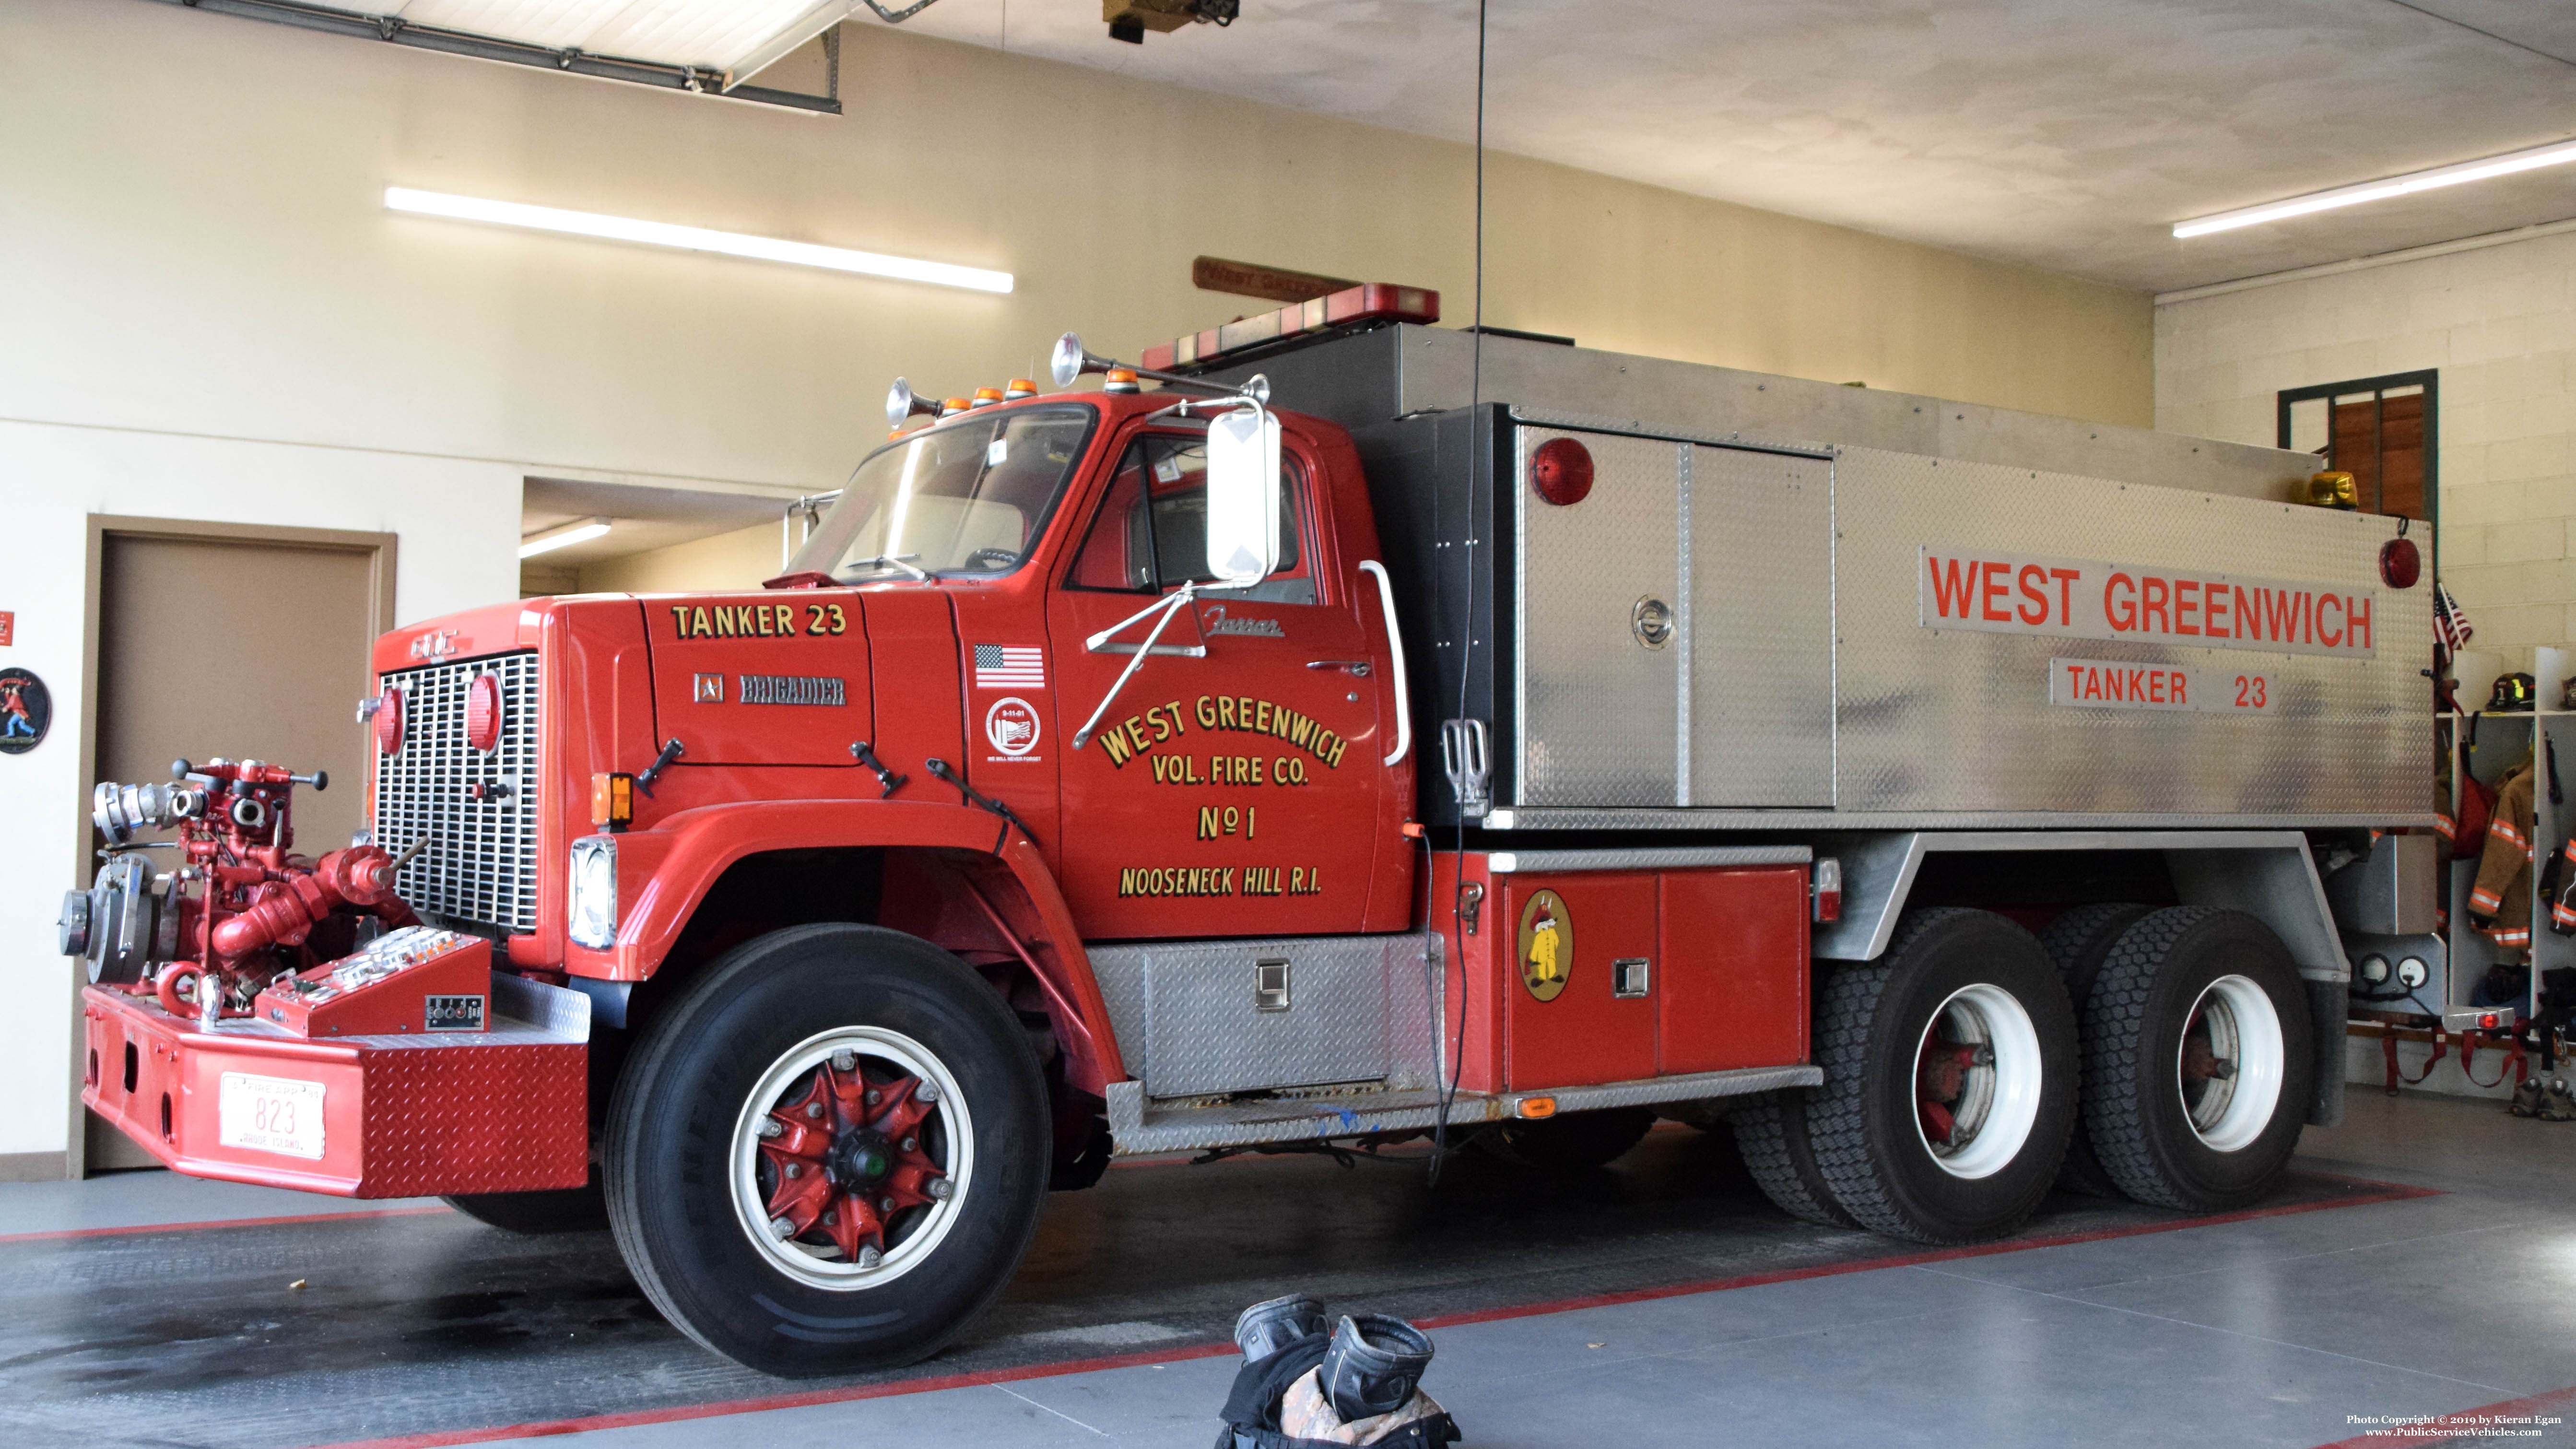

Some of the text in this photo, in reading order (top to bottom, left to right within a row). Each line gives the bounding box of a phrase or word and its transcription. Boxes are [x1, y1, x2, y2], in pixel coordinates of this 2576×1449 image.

[1929, 556, 2371, 648] WEST GREENWICH
[671, 604, 847, 639] TANKER 23
[740, 674, 846, 706] BRIGADIER
[2067, 665, 2267, 708] TANKER 23
[1099, 700, 1185, 768] WEST
[1195, 695, 1347, 768] GREENWICH
[1152, 754, 1309, 786] VOL. FIRE CO.
[1118, 866, 1321, 897] NOOSENECK HILL R.I.
[248, 1083, 272, 1094] FIRE
[256, 1097, 295, 1134] 823
[243, 1132, 300, 1150] RHODE ISLAND
